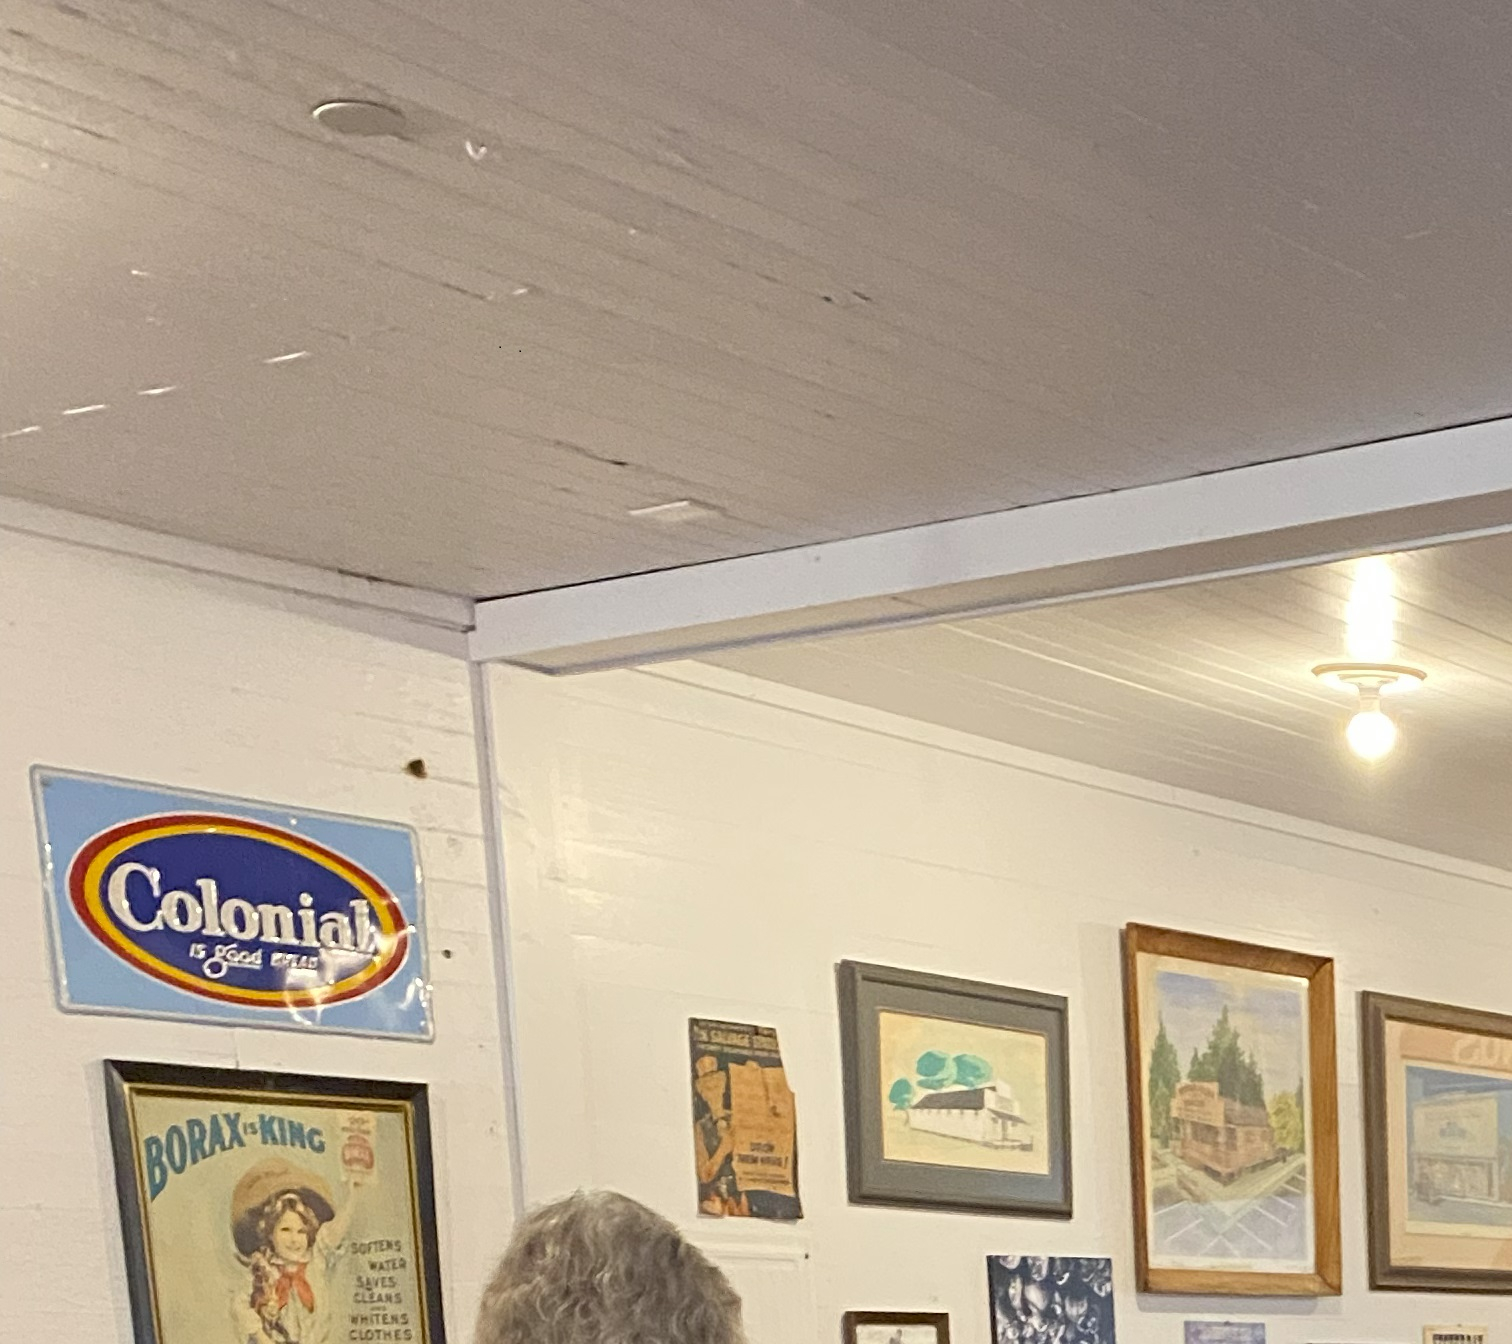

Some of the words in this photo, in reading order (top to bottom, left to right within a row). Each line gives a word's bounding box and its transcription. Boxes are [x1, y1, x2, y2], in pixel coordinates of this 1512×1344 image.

[108, 862, 377, 954] Colonial
[203, 942, 263, 978] good
[144, 1112, 246, 1203] BORAX
[258, 1113, 326, 1154] KING
[350, 1239, 402, 1255] SOFTENS
[368, 1257, 406, 1271] WATER
[356, 1275, 397, 1288] SAVES
[353, 1292, 402, 1304] CLEANS
[350, 1313, 409, 1325] WHITENS
[349, 1328, 413, 1341] CLOTHES
